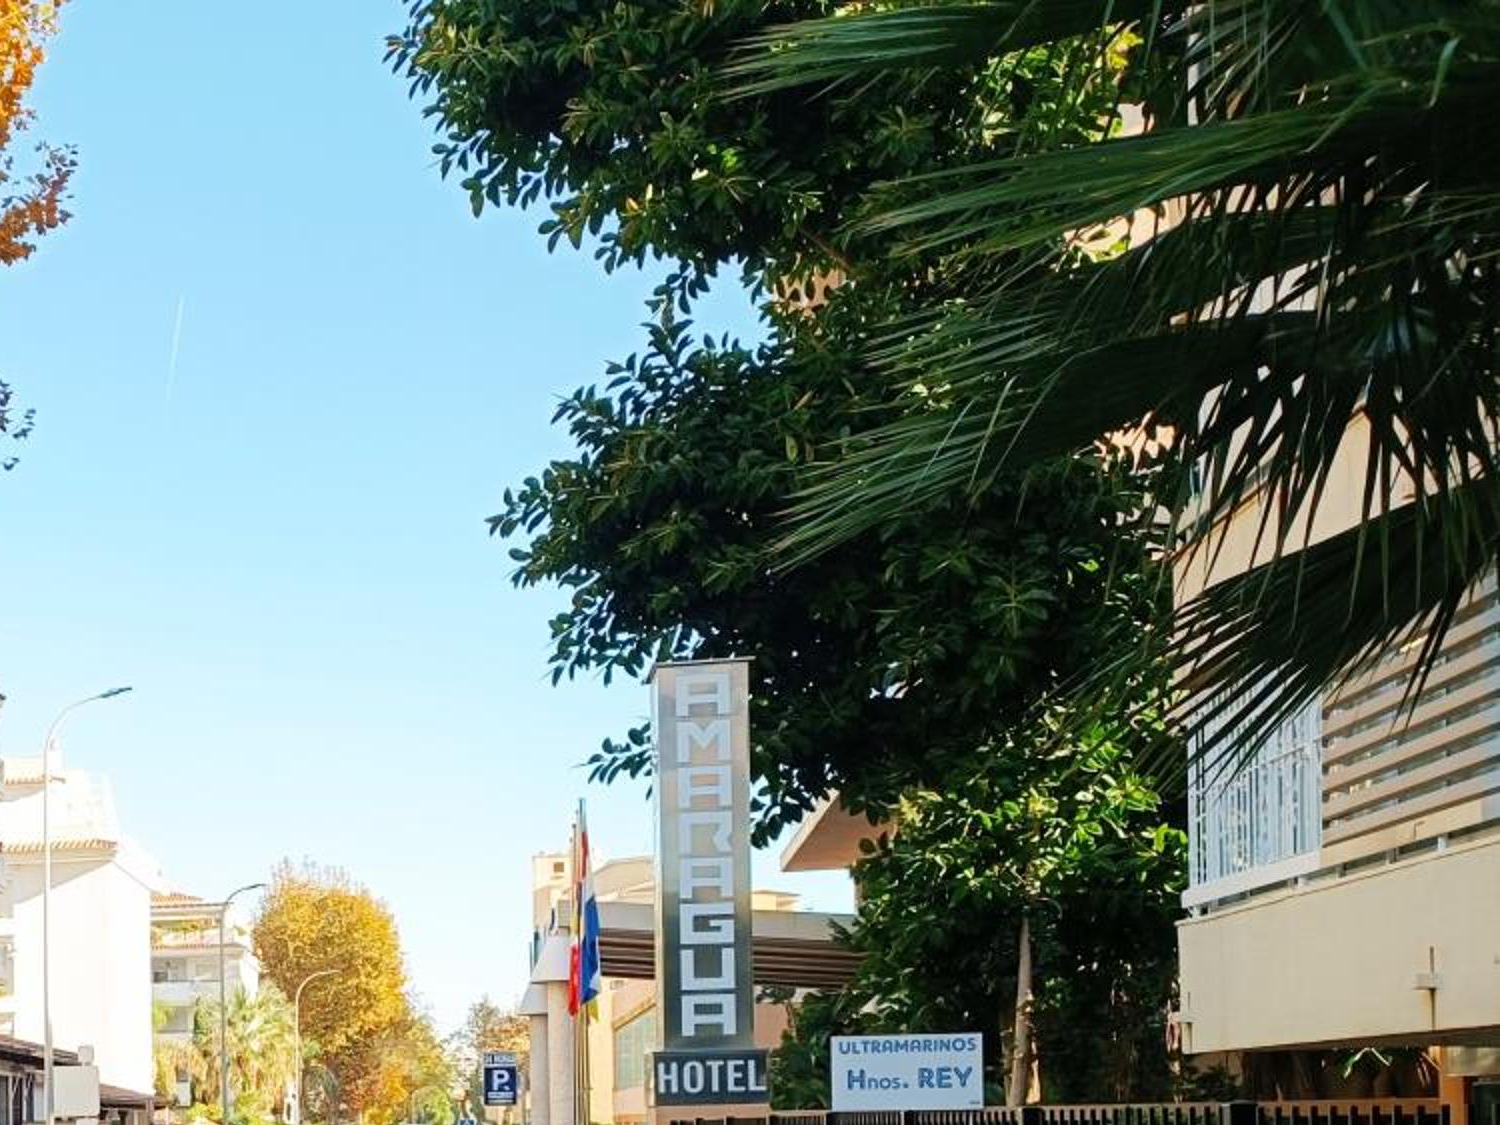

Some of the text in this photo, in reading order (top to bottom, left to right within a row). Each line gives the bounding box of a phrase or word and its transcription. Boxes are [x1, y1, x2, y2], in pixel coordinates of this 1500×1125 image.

[674, 670, 737, 1038] AMARAGUA
[838, 1037, 977, 1055] ULTRAMARINOS
[657, 1059, 768, 1094] HOTEL
[846, 1065, 973, 1090] Hnos. REY
